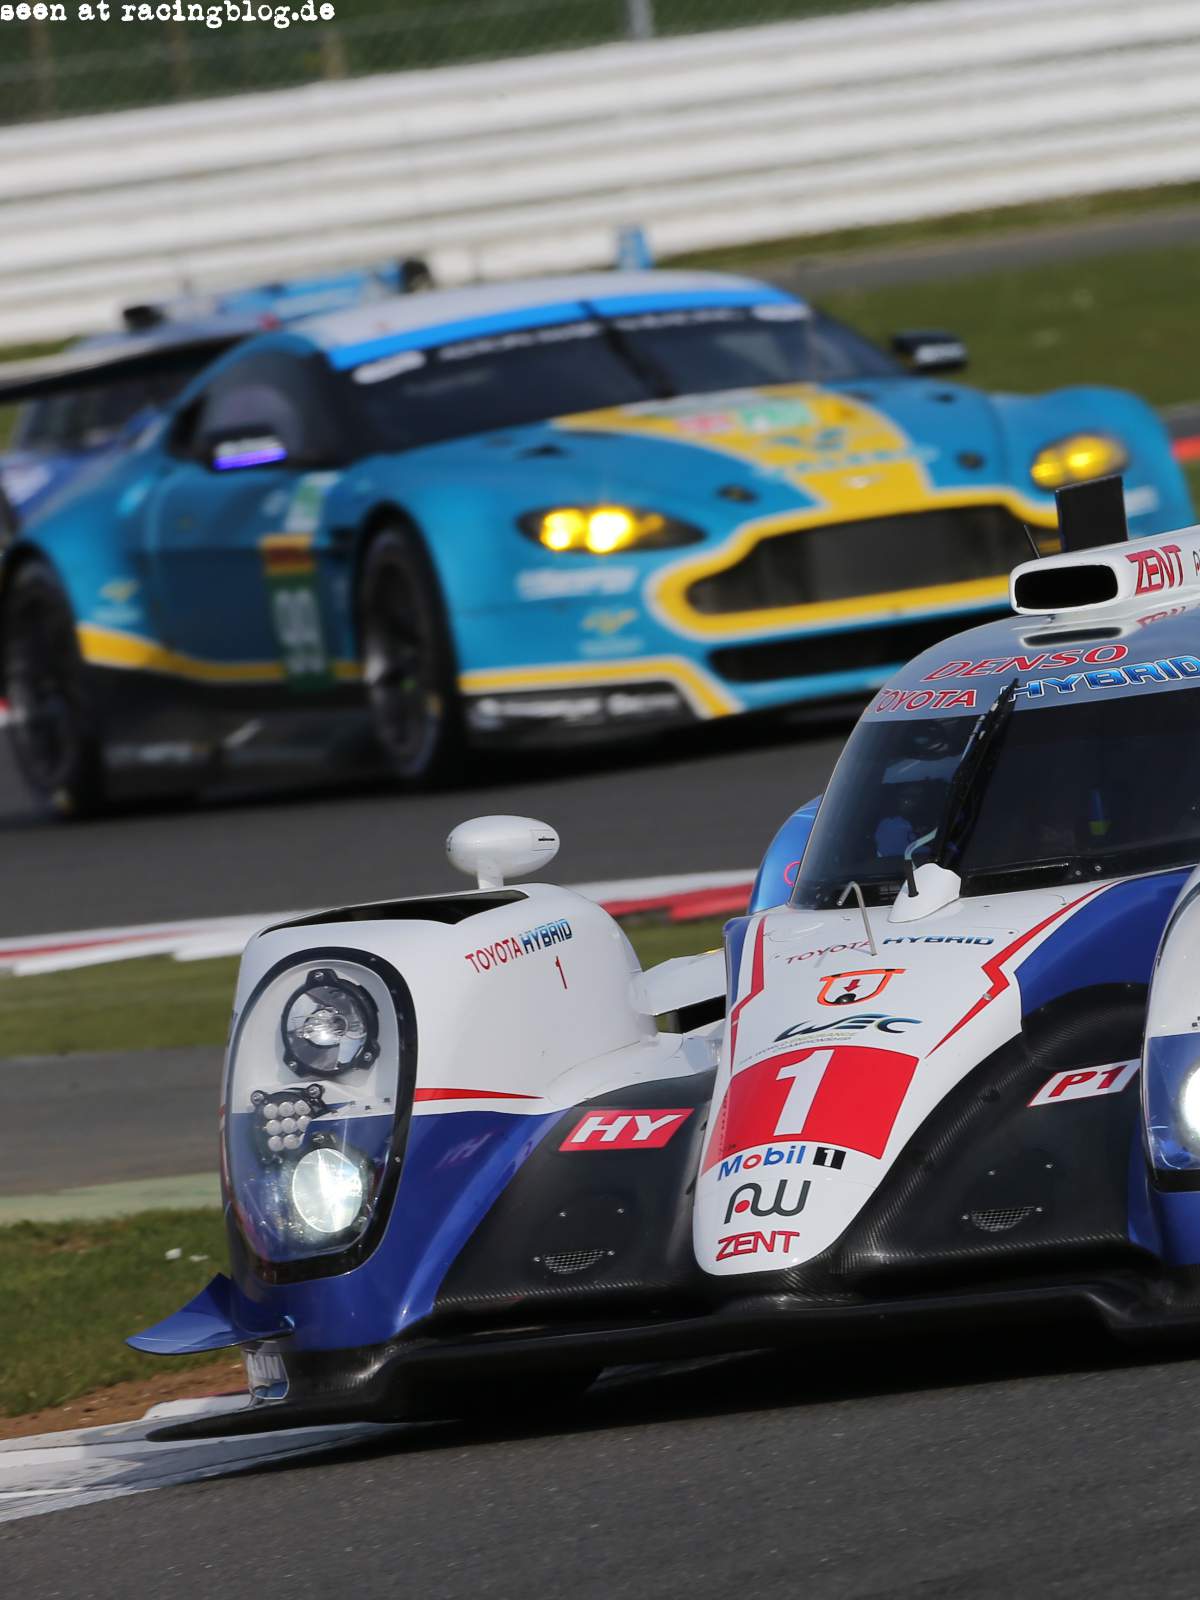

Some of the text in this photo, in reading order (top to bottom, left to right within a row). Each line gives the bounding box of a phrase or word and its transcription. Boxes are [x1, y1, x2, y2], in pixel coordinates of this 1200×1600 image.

[1125, 544, 1185, 596] ZENT
[922, 644, 1130, 682] DENSO
[465, 918, 573, 974] TOYOTA HYBRID
[785, 935, 994, 964] TOYOTA HYBRID
[555, 955, 568, 990] 1
[773, 1013, 923, 1042] WEC
[773, 1049, 836, 1137] 1
[1048, 1066, 1128, 1098] P1
[570, 1114, 684, 1143] HY
[717, 1146, 806, 1181] Mobil
[716, 1231, 800, 1262] ZENT
